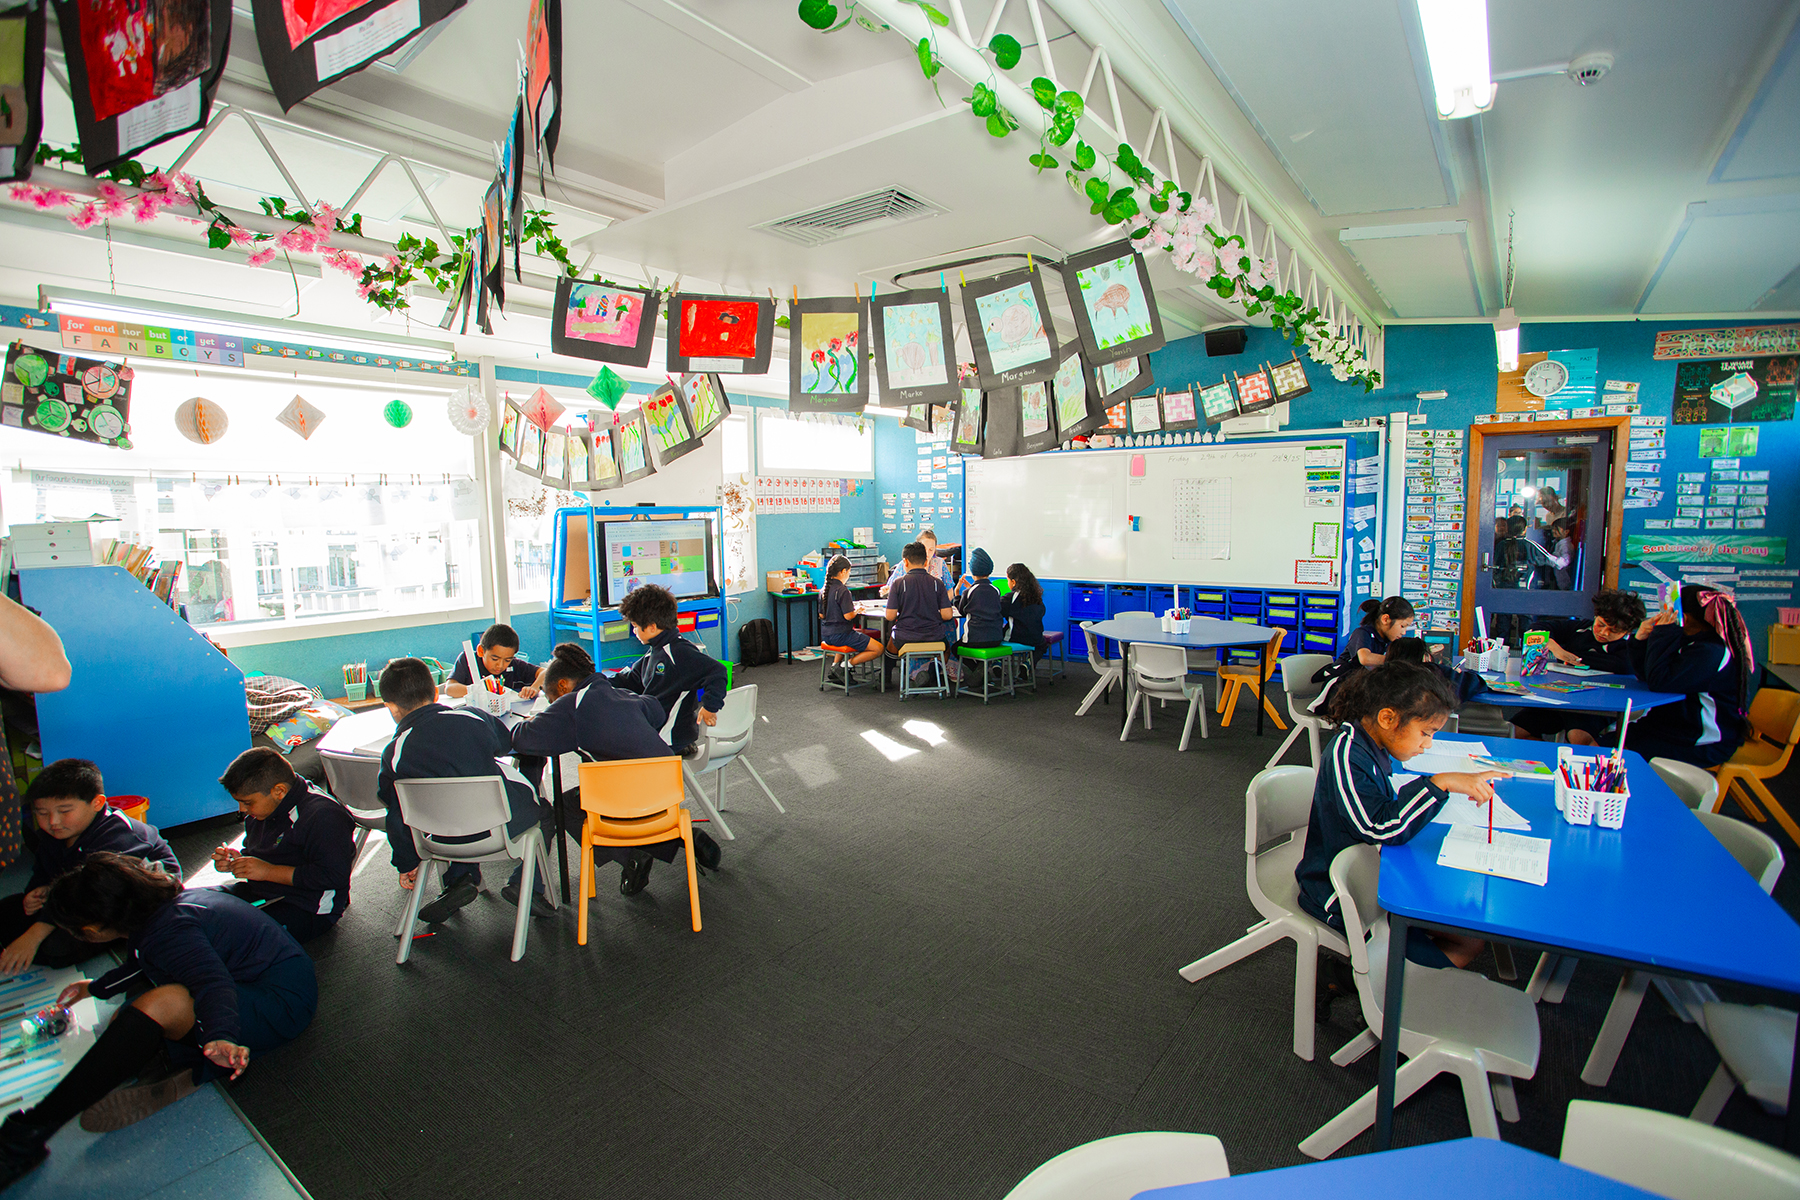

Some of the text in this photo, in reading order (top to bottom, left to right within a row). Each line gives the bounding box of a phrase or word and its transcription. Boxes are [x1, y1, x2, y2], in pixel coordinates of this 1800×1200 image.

[67, 320, 84, 330] for
[94, 325, 115, 334] and
[122, 328, 141, 337] nor
[149, 331, 167, 340] but
[200, 338, 215, 346] yet
[74, 335, 236, 362] F A N B O Y S
[1680, 338, 1697, 350] Te
[1704, 337, 1736, 349] Reo
[1168, 455, 1190, 465] Friday
[1232, 452, 1257, 462] August
[93, 478, 111, 486] Holiday
[1643, 544, 1769, 556] Sentence of the Day
